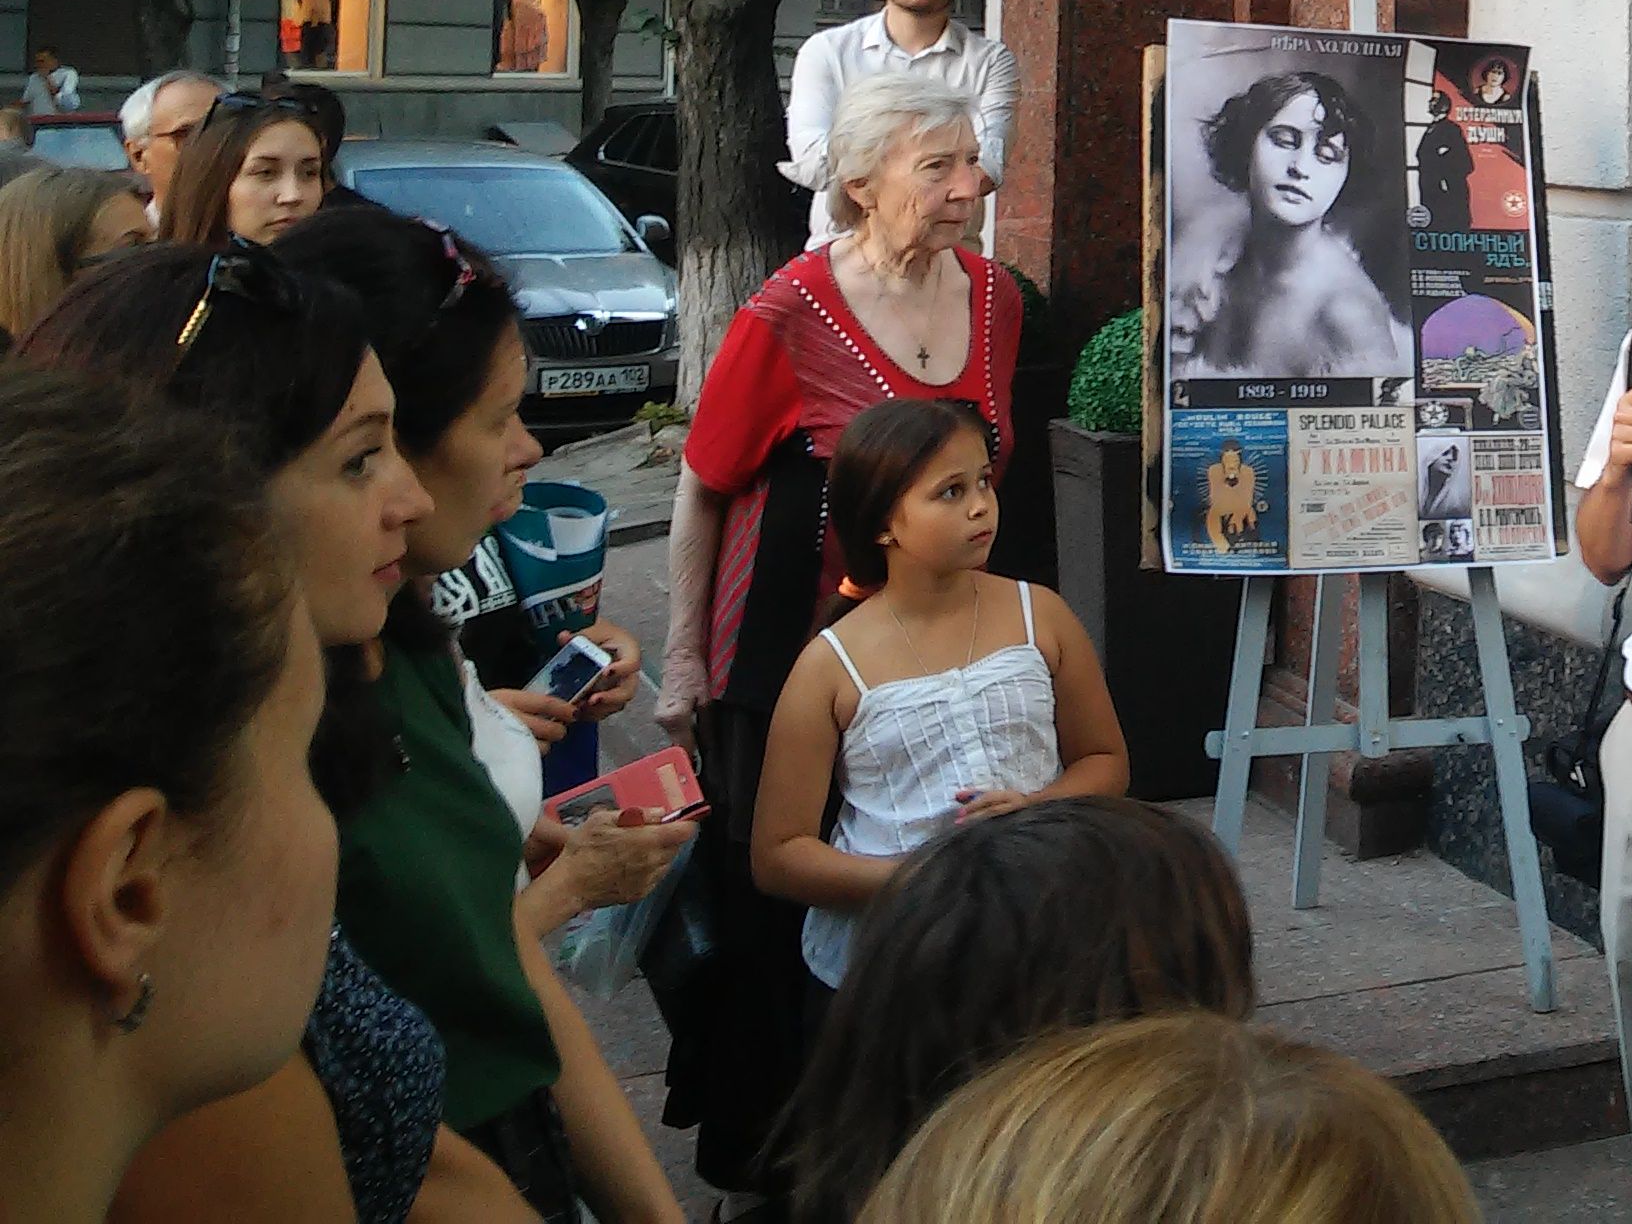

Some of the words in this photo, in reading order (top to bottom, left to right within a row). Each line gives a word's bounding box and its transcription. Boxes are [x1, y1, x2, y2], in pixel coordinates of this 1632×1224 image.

[1238, 384, 1275, 399] 1893
[1290, 384, 1328, 398] 1919
[1299, 414, 1356, 430] SPLENDID
[1361, 413, 1407, 429] PALACE
